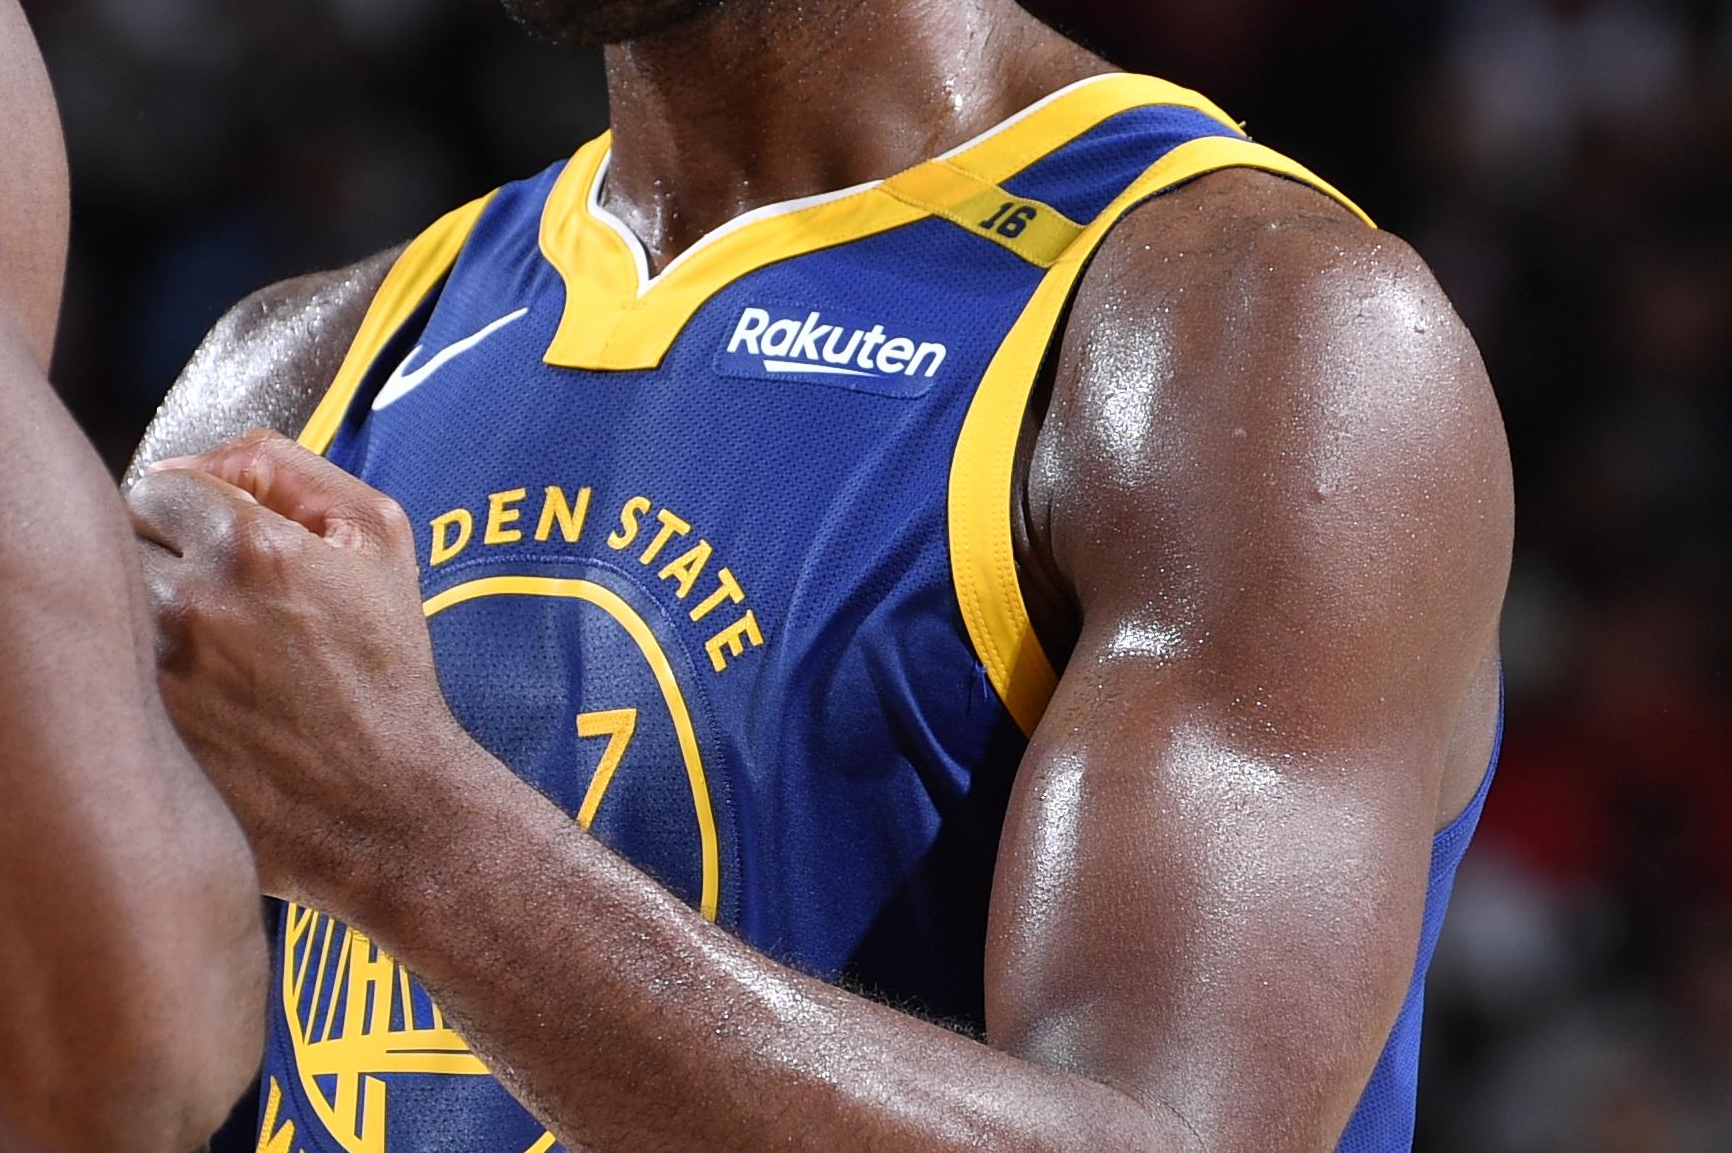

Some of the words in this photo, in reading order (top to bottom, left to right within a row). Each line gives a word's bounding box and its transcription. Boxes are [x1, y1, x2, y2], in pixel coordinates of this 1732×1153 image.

[979, 201, 1038, 240] 16
[726, 306, 948, 378] Rakuten
[428, 485, 592, 567] DEN
[606, 495, 765, 673] STATE
[575, 707, 637, 832] 7
